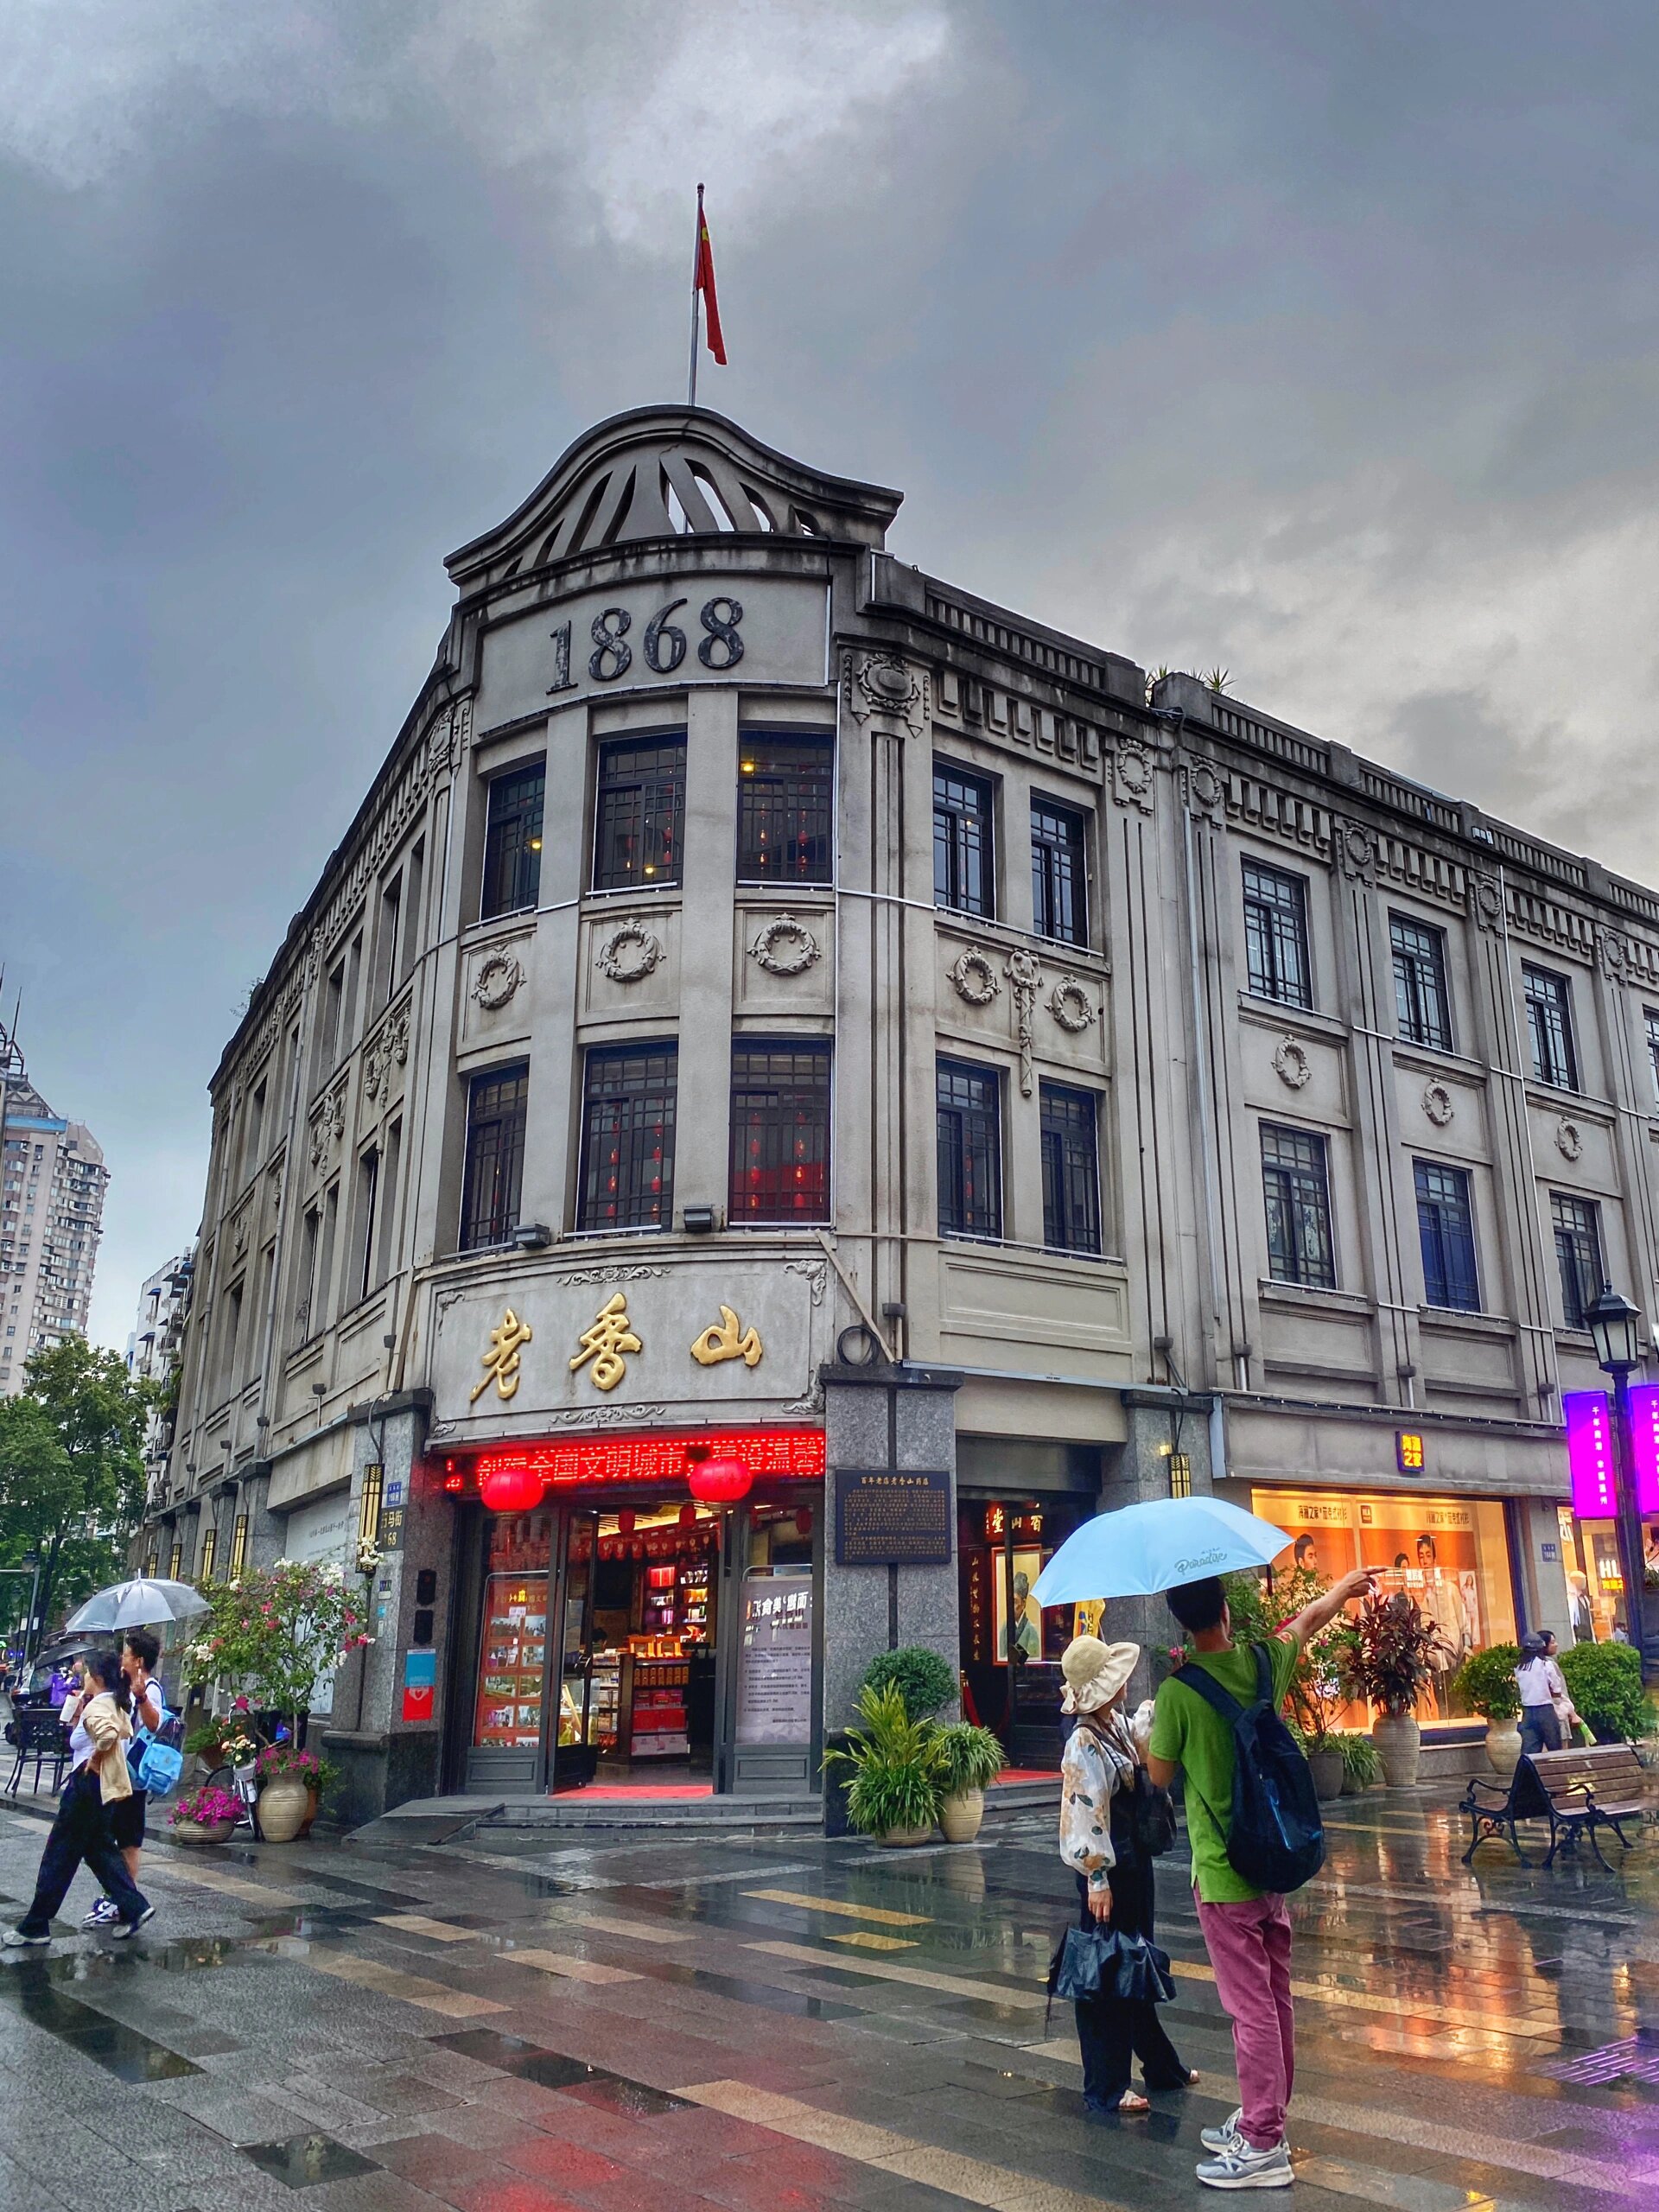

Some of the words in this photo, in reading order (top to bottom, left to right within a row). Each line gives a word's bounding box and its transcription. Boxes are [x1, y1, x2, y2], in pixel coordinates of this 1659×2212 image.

[546, 596, 744, 695] 1868
[469, 1291, 764, 1401] 老香山
[384, 1531, 397, 1546] 68
[1174, 1552, 1228, 1576] Paradise
